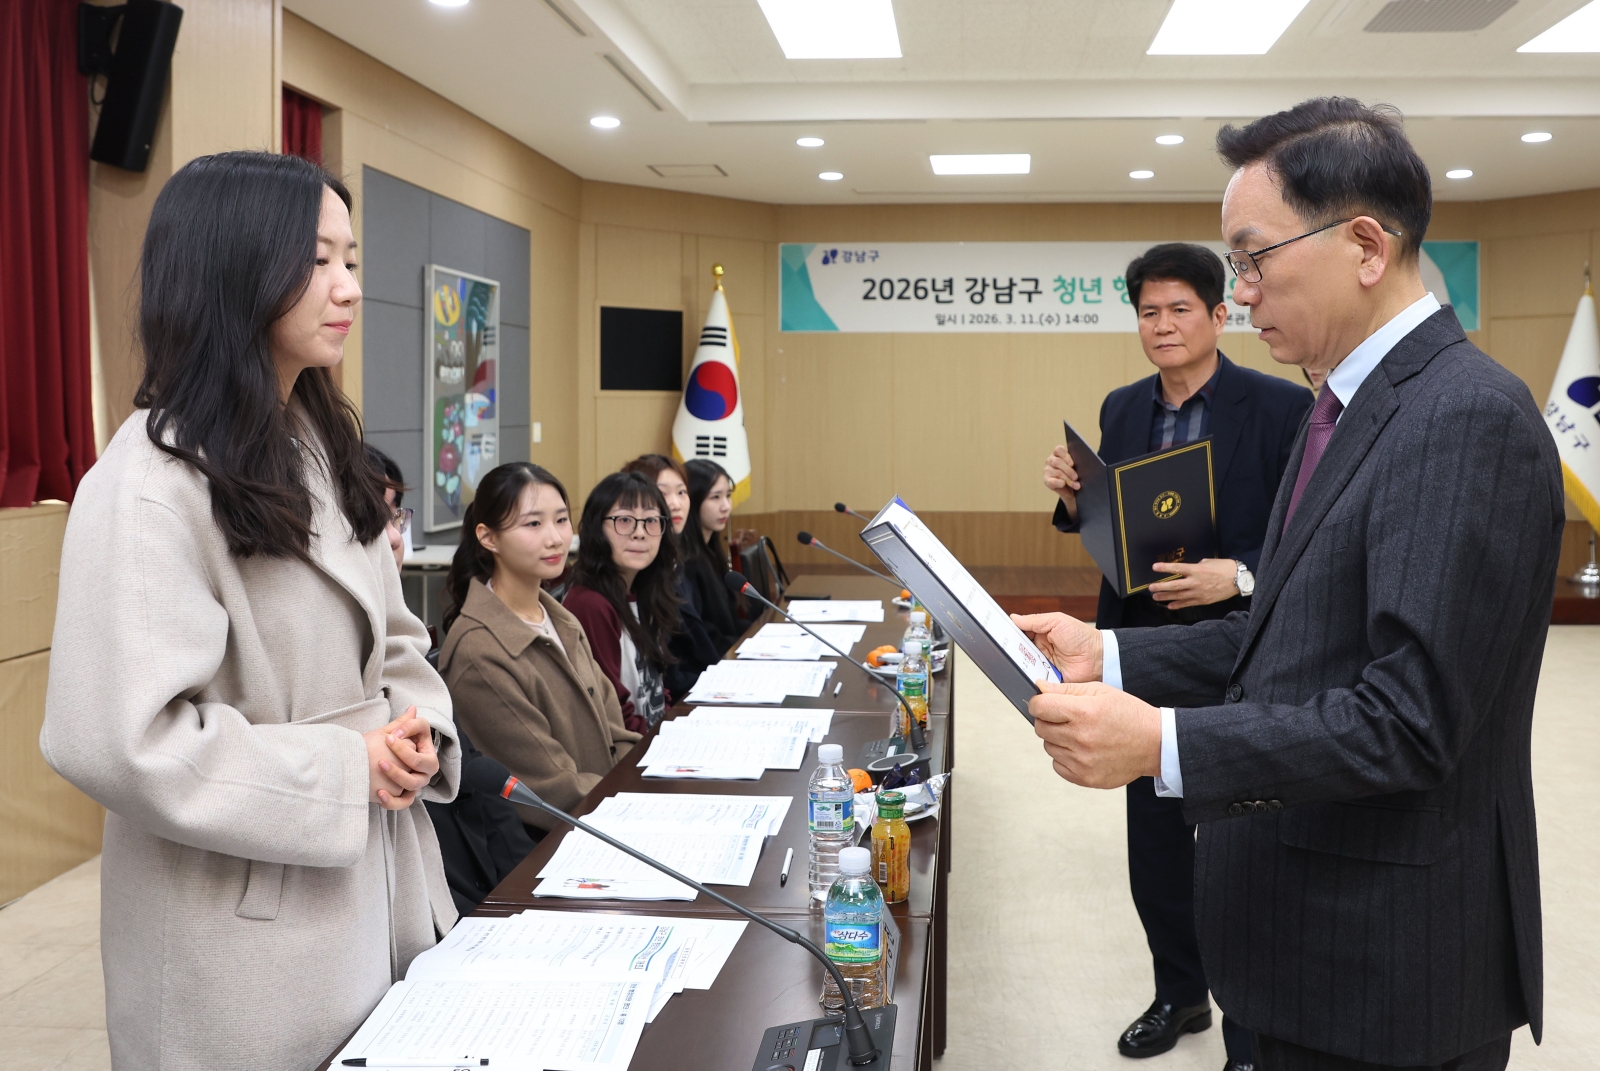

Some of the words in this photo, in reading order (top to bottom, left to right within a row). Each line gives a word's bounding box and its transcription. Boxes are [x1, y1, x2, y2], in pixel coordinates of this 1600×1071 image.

[842, 250, 880, 263] 강남구
[862, 277, 954, 304] 2026년
[965, 277, 1042, 304] 강남구
[1053, 275, 1102, 304] 청년
[935, 313, 957, 326] 일시
[1065, 313, 1099, 325] 14:00
[835, 930, 869, 941] 삼다수
